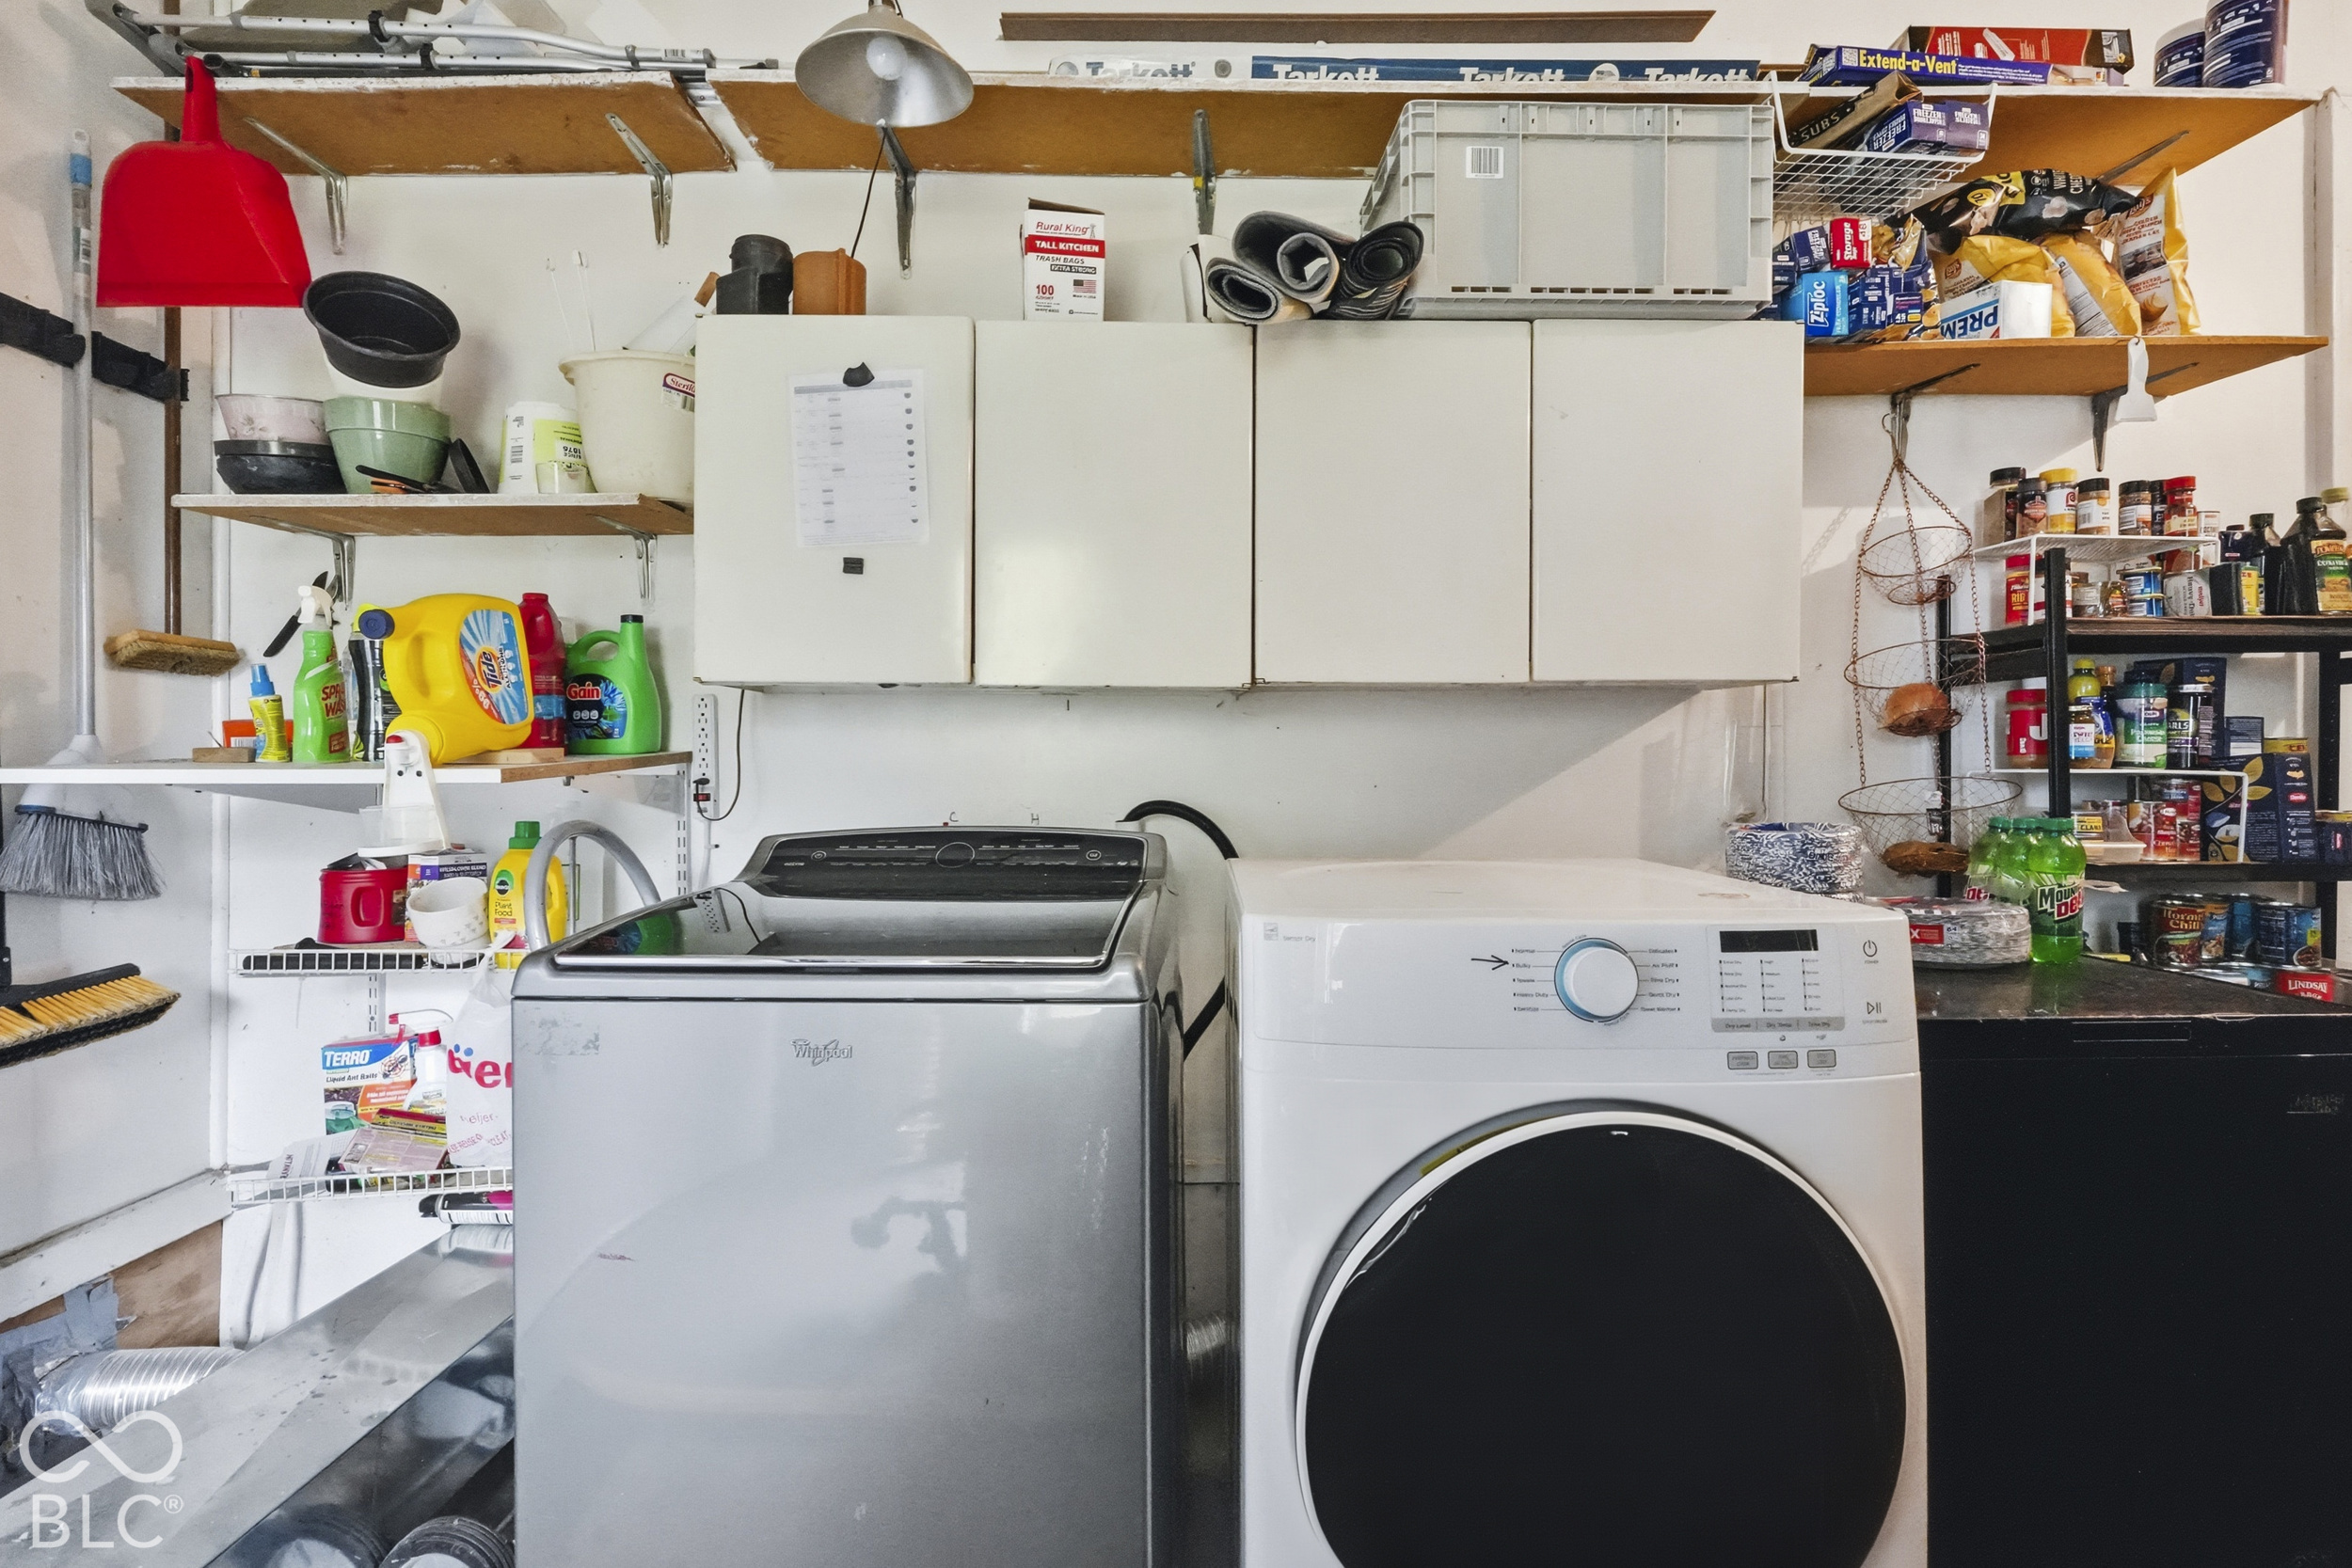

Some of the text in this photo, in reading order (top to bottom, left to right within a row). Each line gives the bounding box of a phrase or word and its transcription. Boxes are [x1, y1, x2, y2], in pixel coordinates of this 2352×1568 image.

[1859, 49, 1958, 74] Extend-a-Vent
[1801, 113, 1841, 142] SUBS
[1037, 222, 1089, 235] Rural King
[1035, 241, 1099, 252] TALL KITCHEN
[1844, 222, 1853, 261] Storage
[1037, 285, 1054, 295] 100
[1810, 280, 1829, 324] Ziploc
[483, 651, 501, 689] Tide
[566, 682, 602, 701] Gain
[1031, 813, 1040, 825] H
[495, 902, 513, 911] Plant
[495, 909, 513, 917] Food
[2288, 979, 2328, 993] LINDSAY
[324, 1050, 370, 1068] TERRO
[790, 1038, 852, 1067] Whirlpool
[326, 1074, 345, 1084] Liquid
[360, 1071, 377, 1081] Baits
